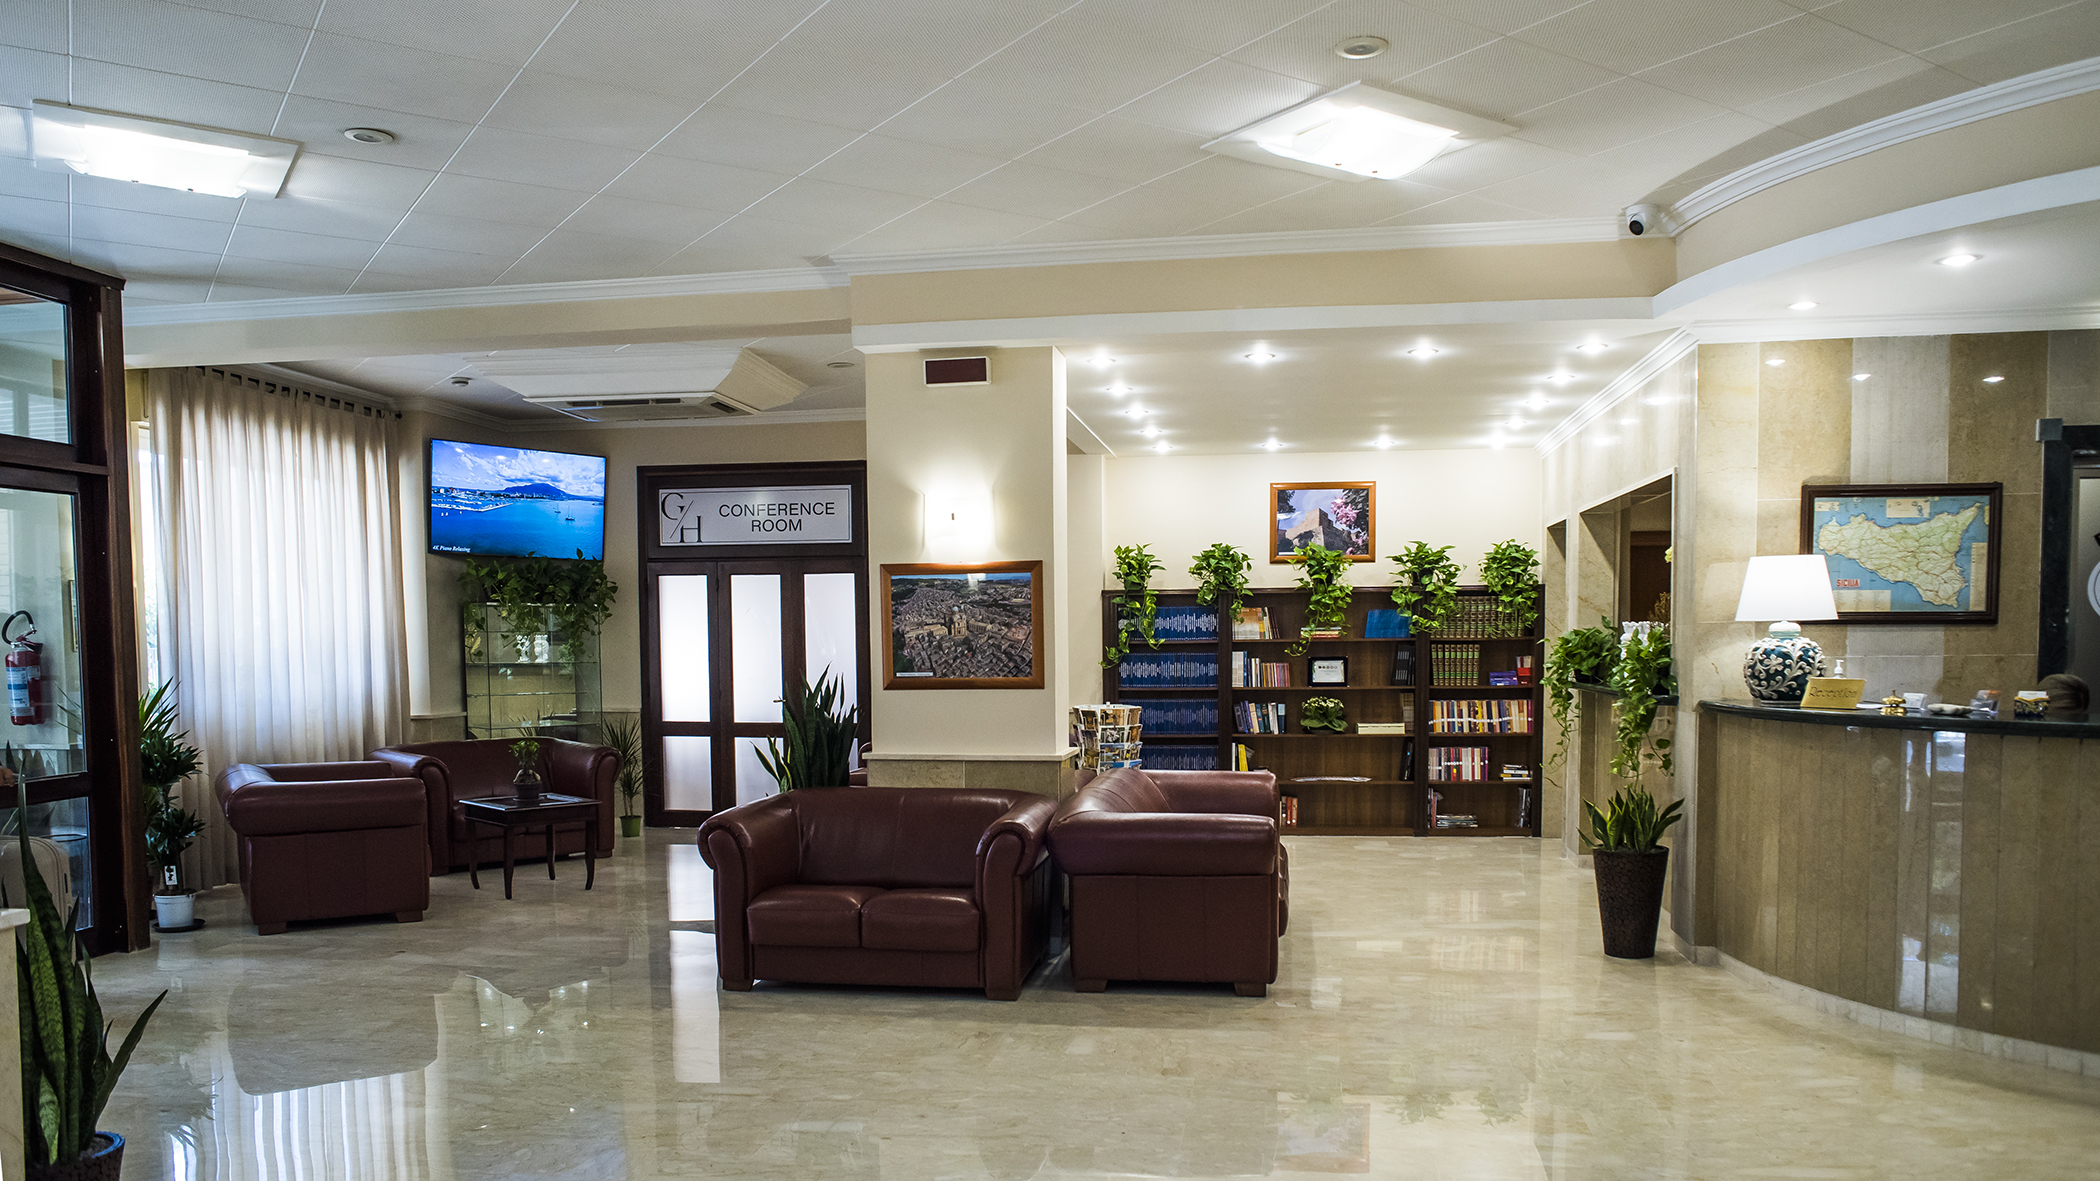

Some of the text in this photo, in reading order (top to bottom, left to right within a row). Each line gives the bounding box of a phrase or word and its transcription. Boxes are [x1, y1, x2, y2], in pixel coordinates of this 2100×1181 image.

[718, 502, 835, 517] CONFERENCE
[751, 519, 802, 532] ROOM
[1836, 579, 1859, 587] SICILIA
[1809, 686, 1857, 700] Reception
